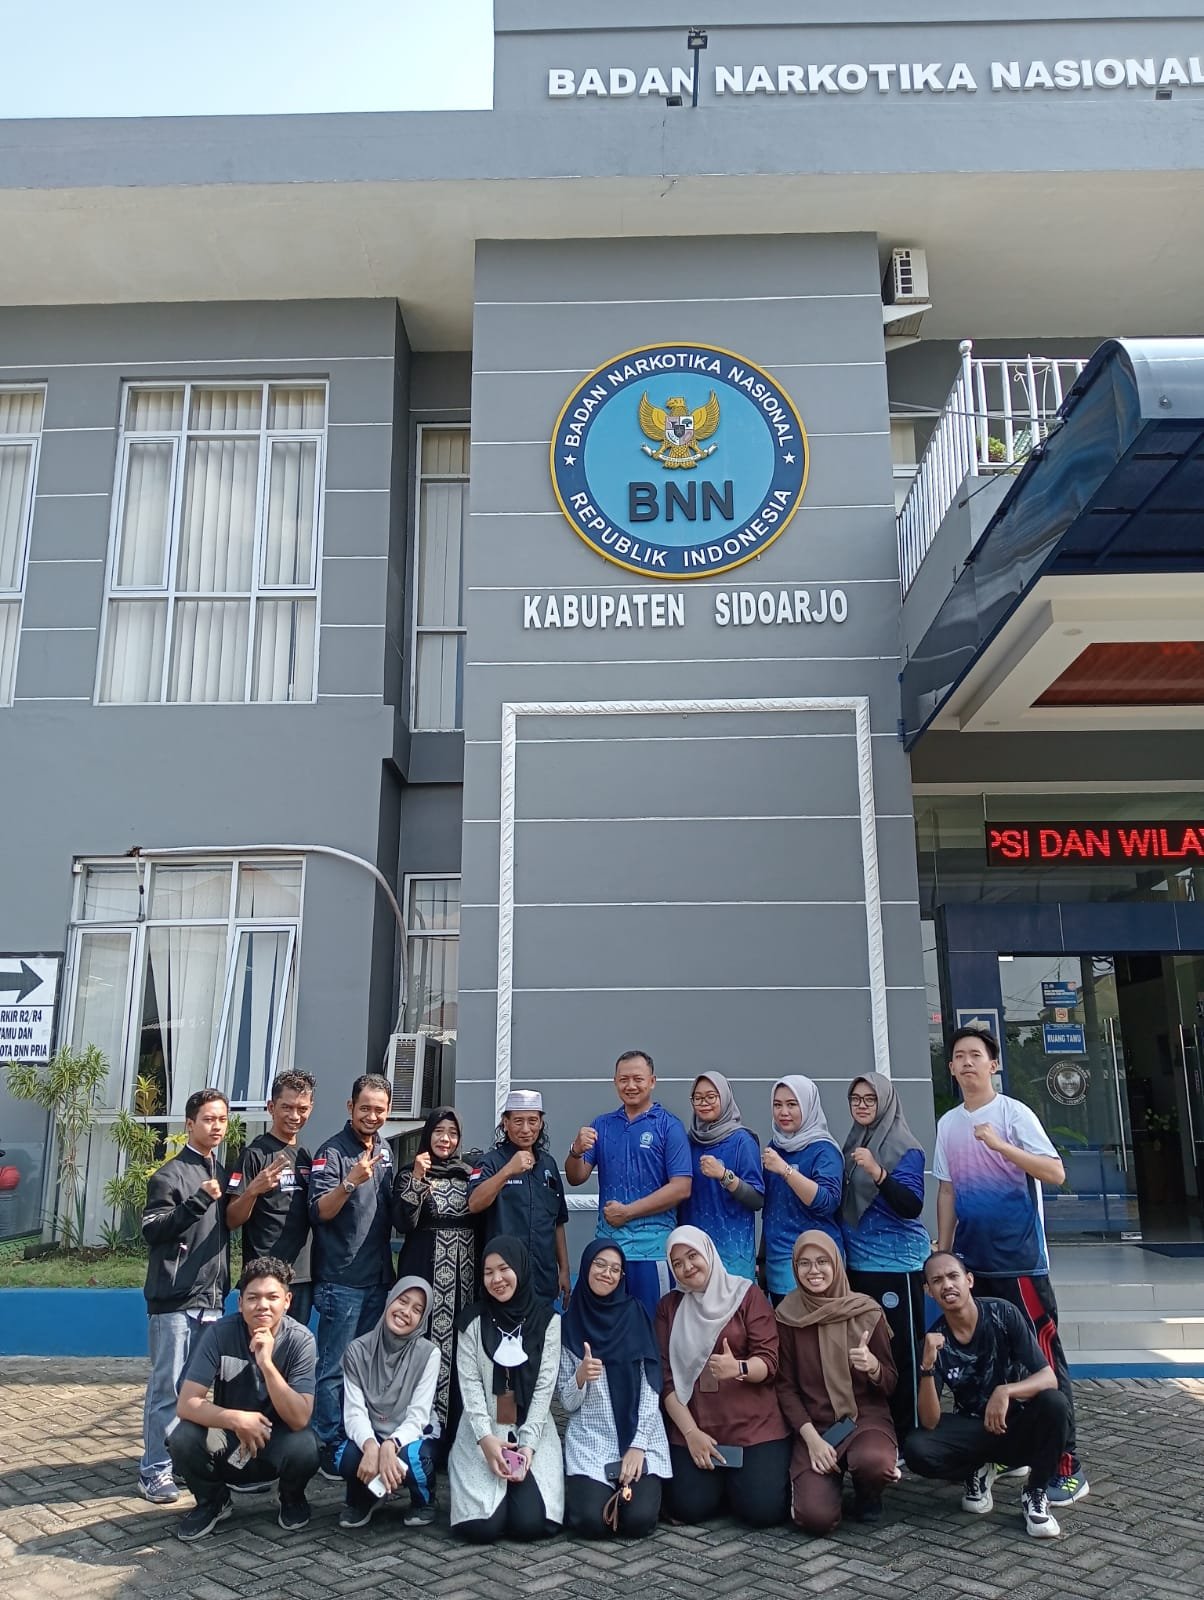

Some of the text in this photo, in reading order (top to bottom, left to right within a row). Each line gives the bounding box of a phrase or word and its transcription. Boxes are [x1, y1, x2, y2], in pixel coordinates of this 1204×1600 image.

[548, 57, 1204, 97] BADAN NARKOTIKA NASIONAL
[564, 353, 794, 448] BADAN NARKOTIKA NASIONAL
[628, 480, 735, 522] BNN
[570, 488, 792, 568] REPUBLIK INDONESIA
[523, 589, 848, 629] KABUPATEN SIDOARJO
[1039, 829, 1111, 857] DAN
[1118, 828, 1204, 857] WILA
[18, 1027, 33, 1039] DAN
[19, 1010, 42, 1023] R2/R4
[14, 1045, 29, 1057] BNN
[31, 1044, 47, 1057] PRIA
